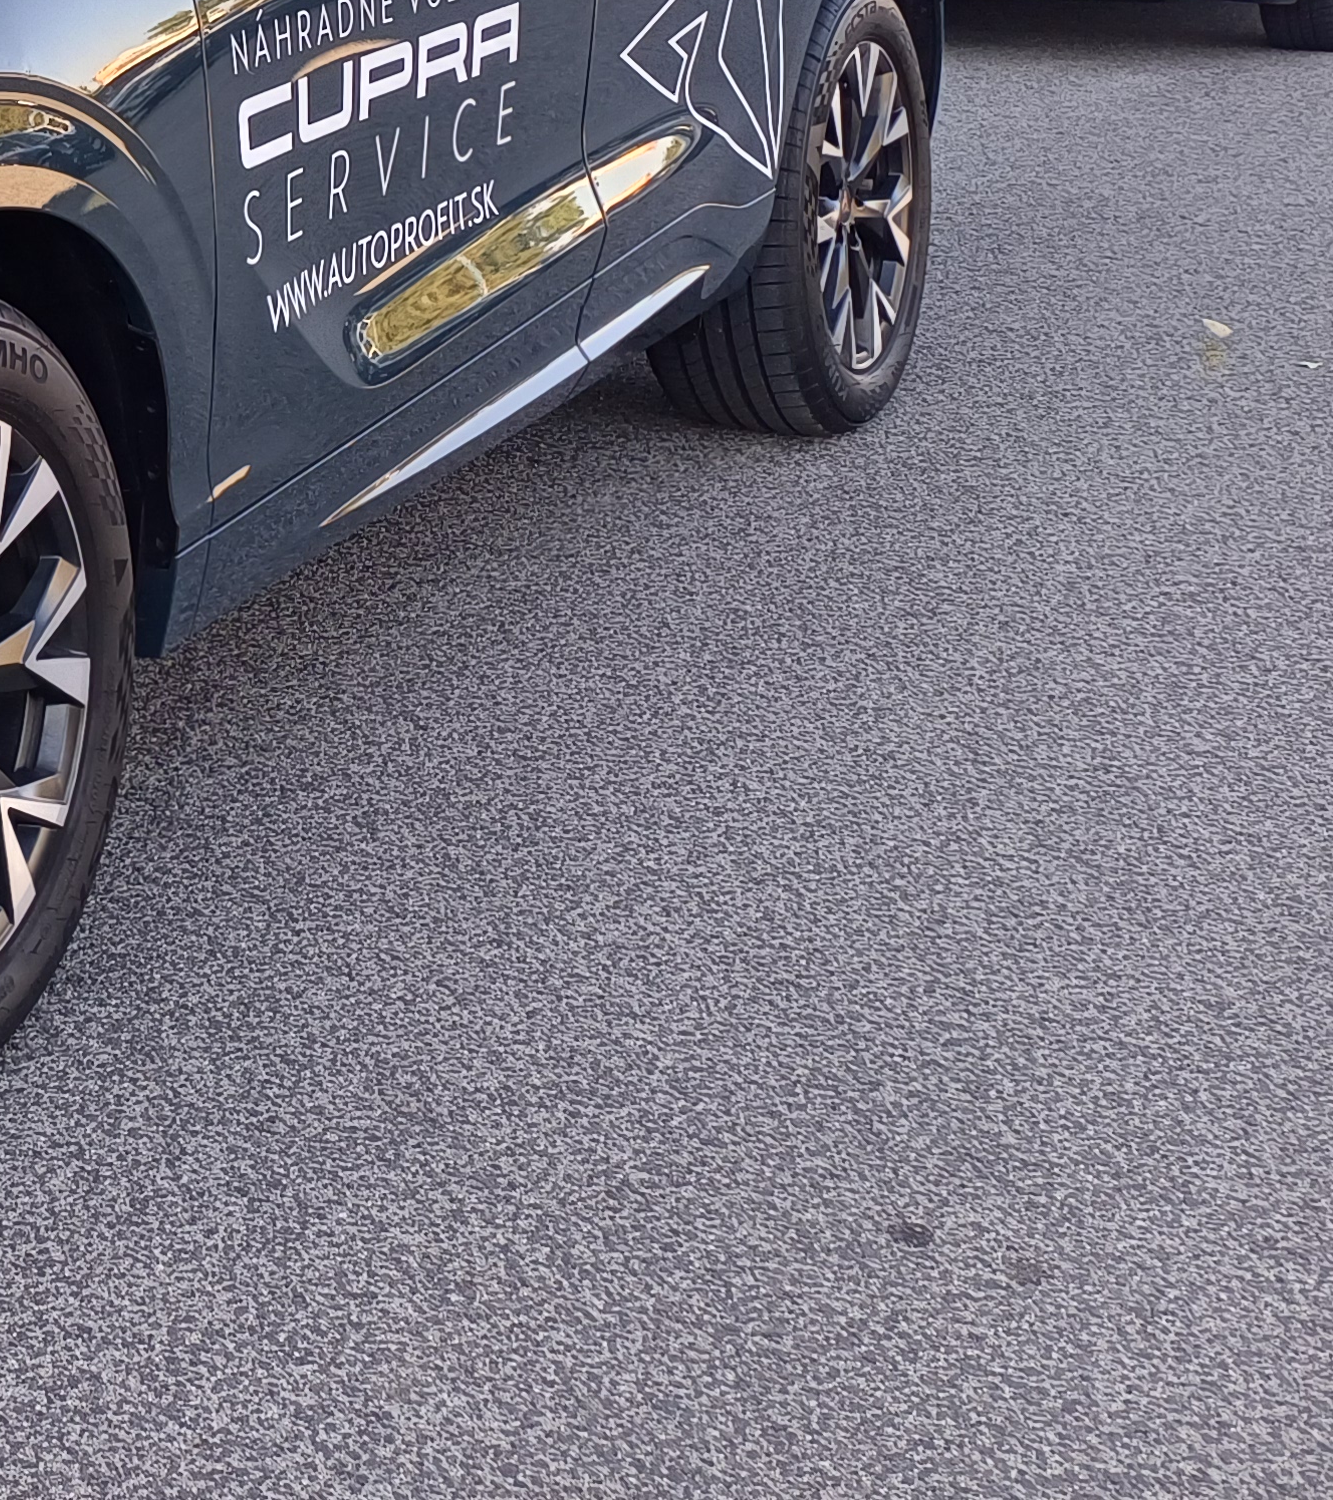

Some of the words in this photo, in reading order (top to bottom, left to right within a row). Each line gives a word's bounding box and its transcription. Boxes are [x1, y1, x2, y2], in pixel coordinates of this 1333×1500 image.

[237, 1, 520, 170] CUPRA
[243, 80, 517, 266] SERVICE
[266, 179, 500, 333] WWW.AUTOPROFIT.SK
